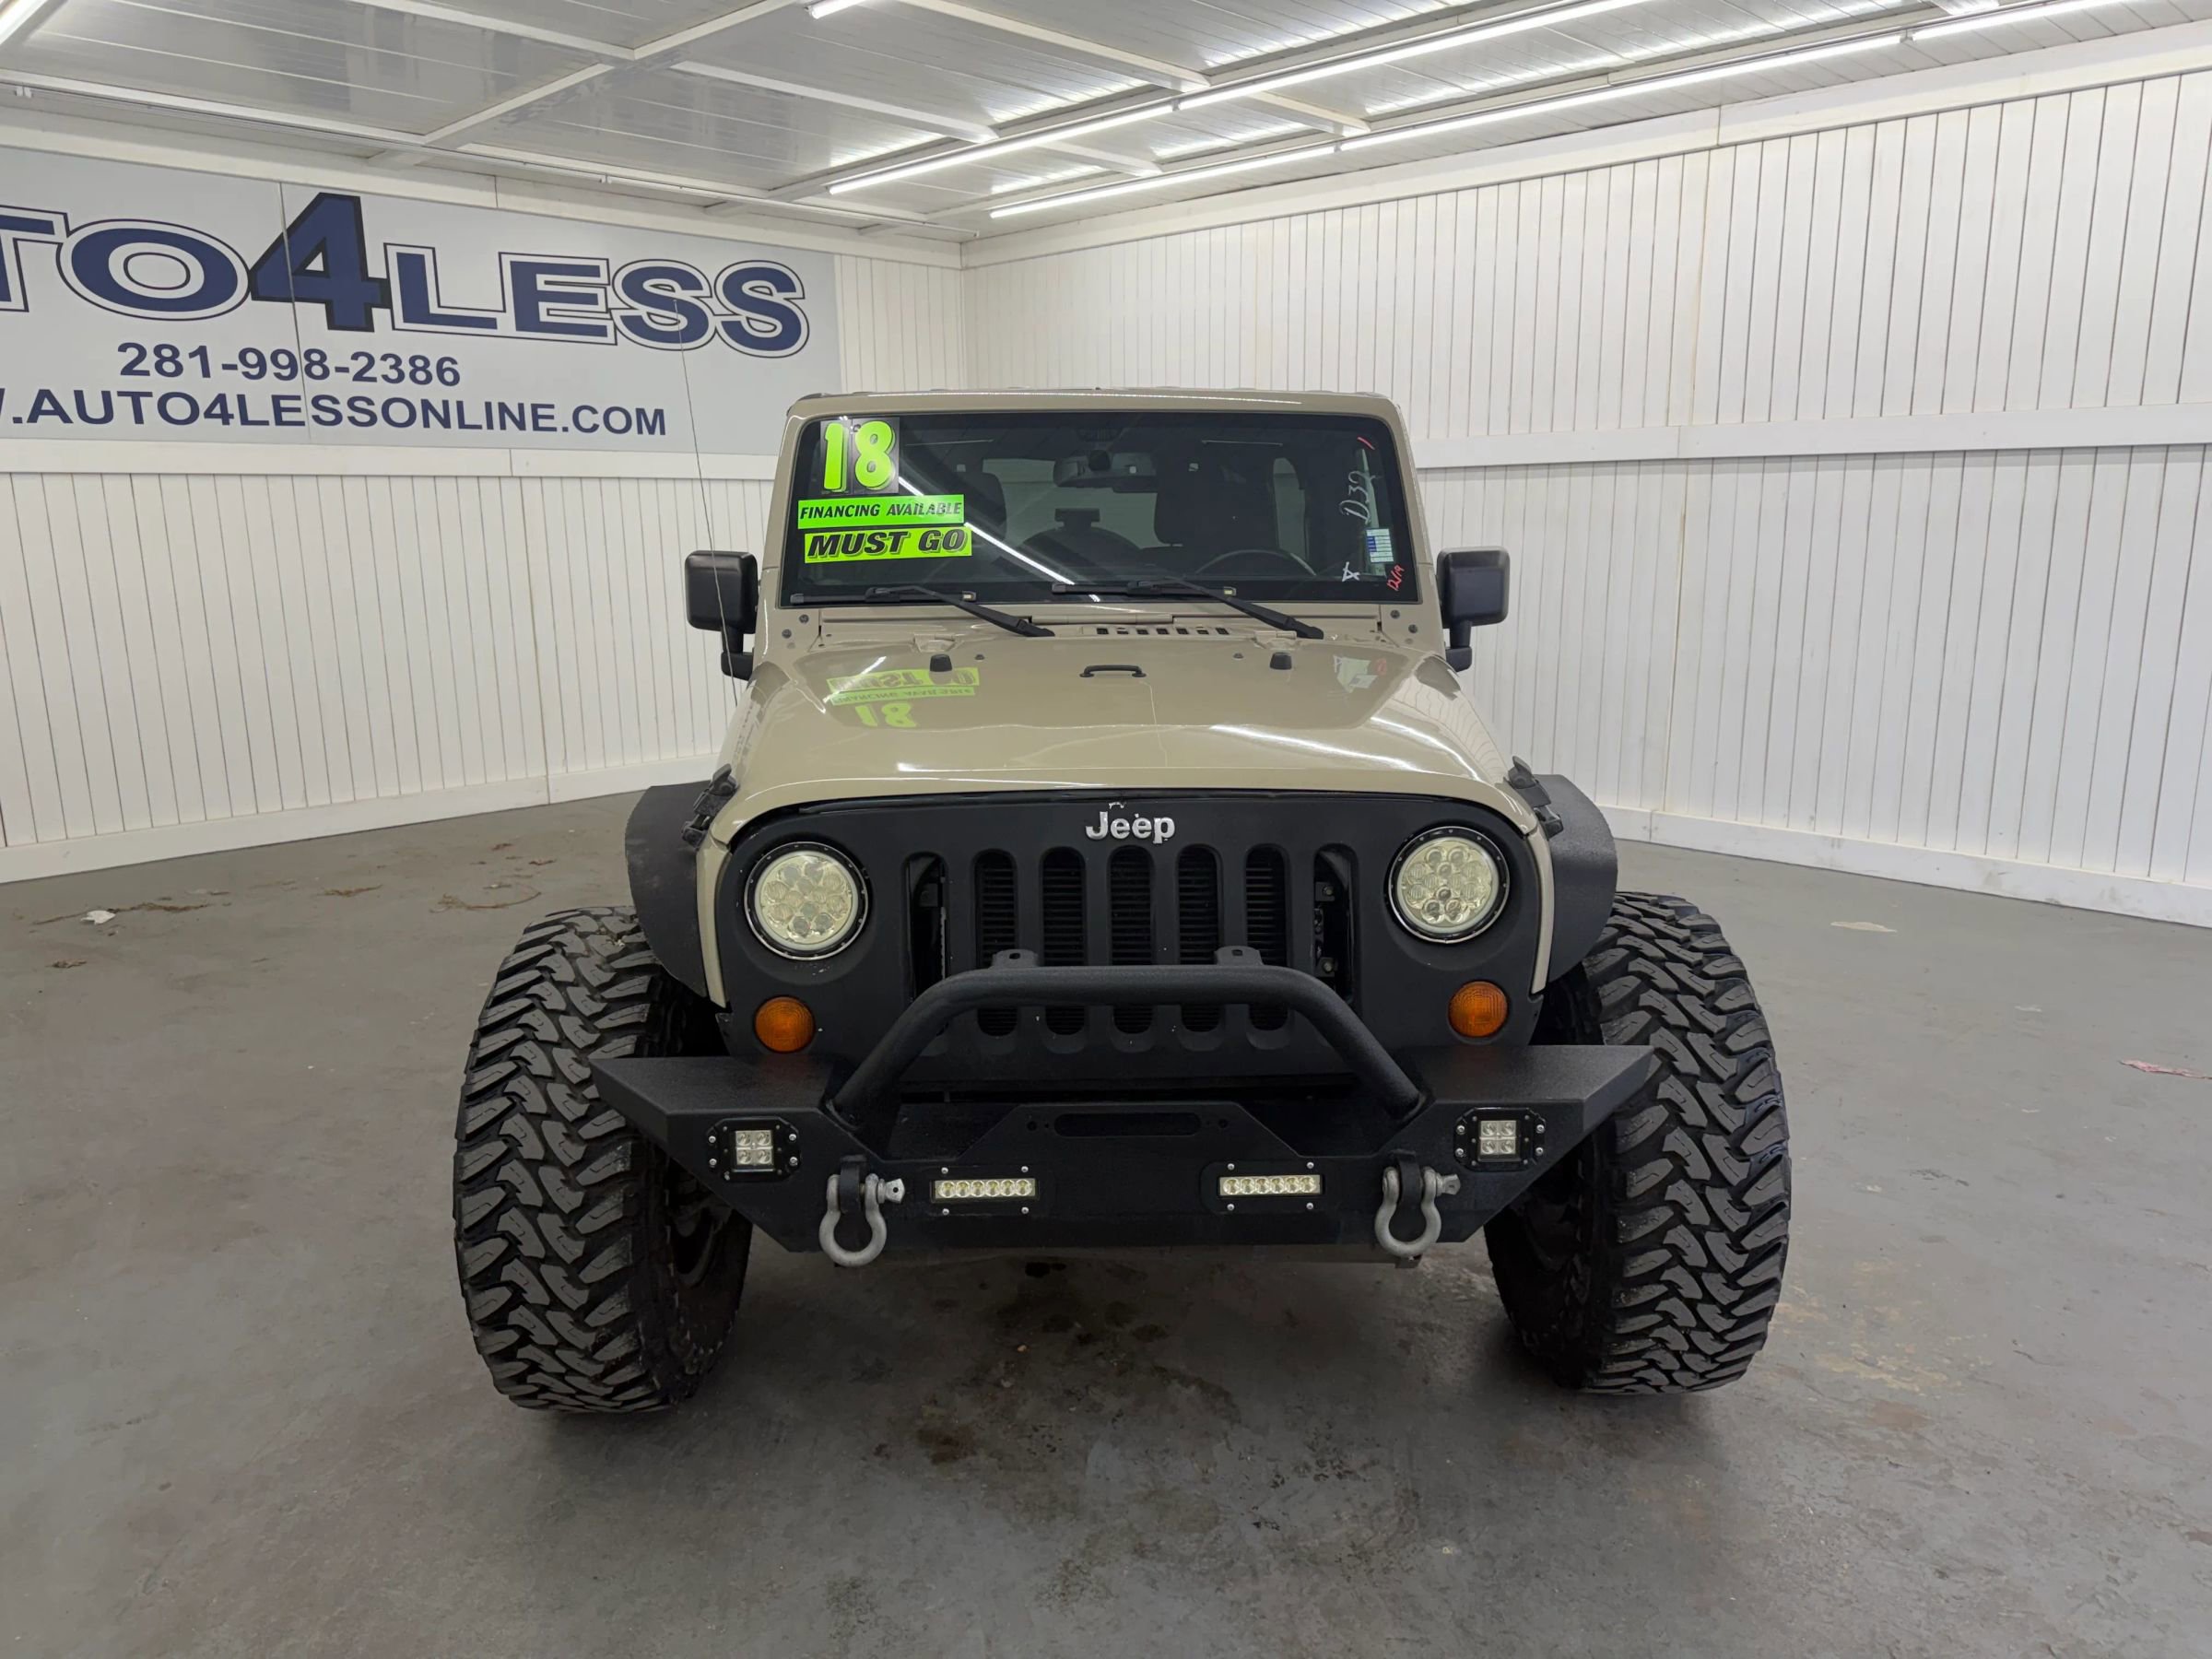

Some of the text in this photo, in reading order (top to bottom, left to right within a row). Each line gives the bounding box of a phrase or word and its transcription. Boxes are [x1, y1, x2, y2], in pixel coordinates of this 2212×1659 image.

[117, 342, 461, 387] 281-998-2386
[0, 387, 666, 436] .AUTO4LESSONLINE.COM
[823, 420, 895, 492] 18
[799, 501, 963, 520] FINANCING AVAILABLE
[807, 528, 968, 559] MUST GO
[1085, 811, 1175, 844] Jeep
